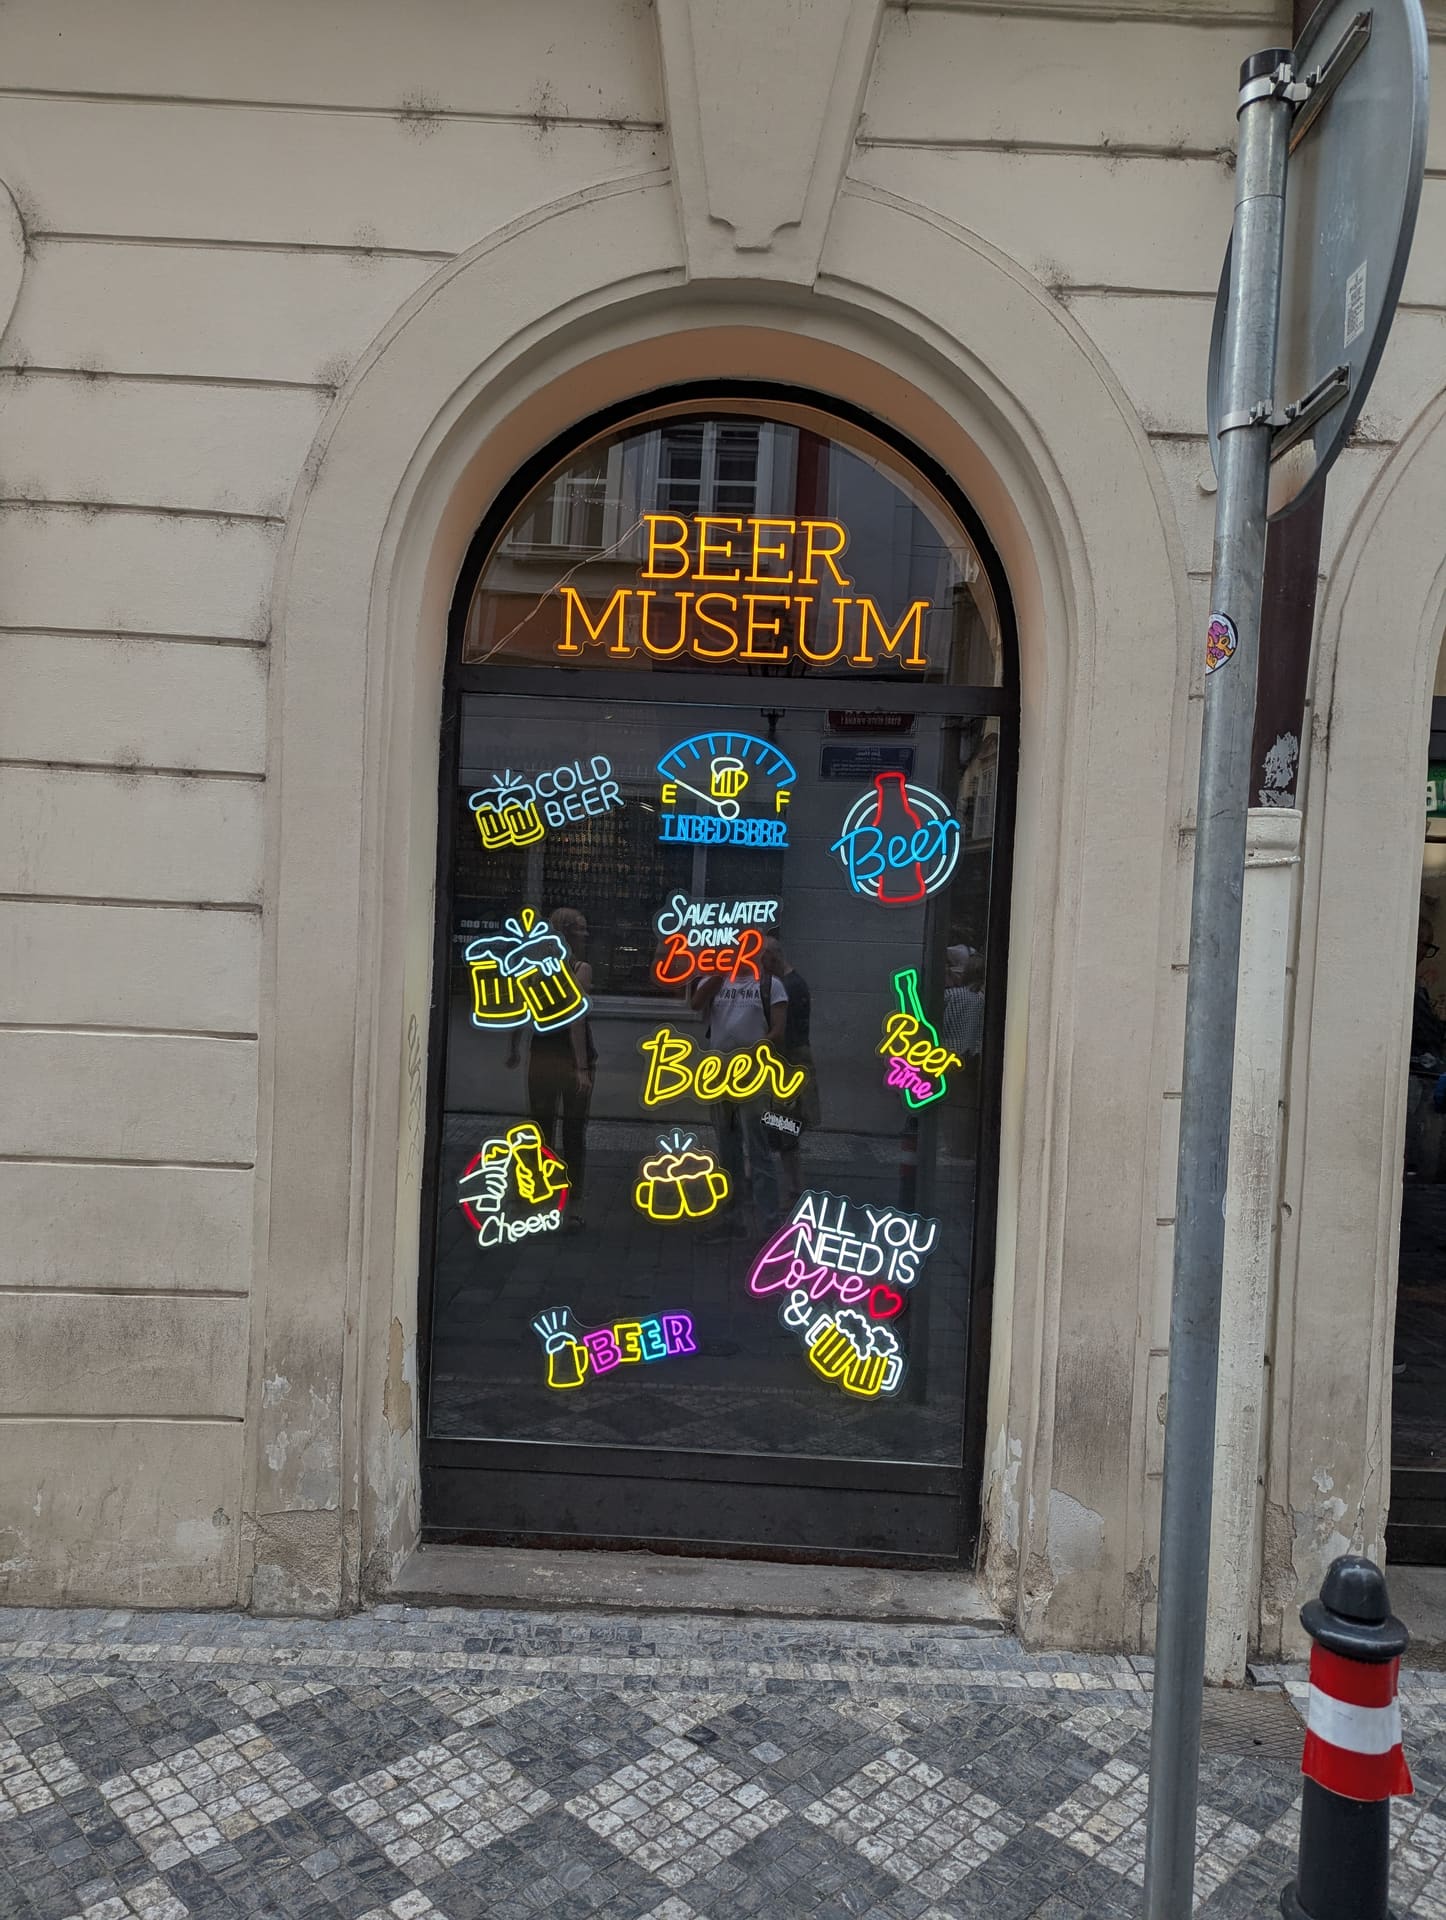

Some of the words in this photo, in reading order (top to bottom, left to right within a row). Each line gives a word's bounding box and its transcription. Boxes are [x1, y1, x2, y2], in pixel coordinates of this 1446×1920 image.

[641, 514, 850, 587] BEER
[557, 587, 930, 666] MUSEUM
[535, 754, 612, 799] COLD
[544, 780, 625, 828] BEER
[661, 783, 678, 804] E
[775, 790, 791, 813] F
[830, 818, 961, 894] Beer
[686, 927, 741, 947] DRINK
[718, 899, 779, 925] WATER
[654, 928, 766, 984] BEER
[641, 1028, 806, 1105] Beer
[880, 1013, 963, 1079] Beer
[478, 1209, 561, 1248] Cheers
[791, 1195, 856, 1238] ALL
[865, 1209, 937, 1253] YOU
[793, 1227, 884, 1277] NEED
[887, 1248, 920, 1285] IS
[783, 1289, 813, 1327] &
[583, 1314, 697, 1375] BEER
